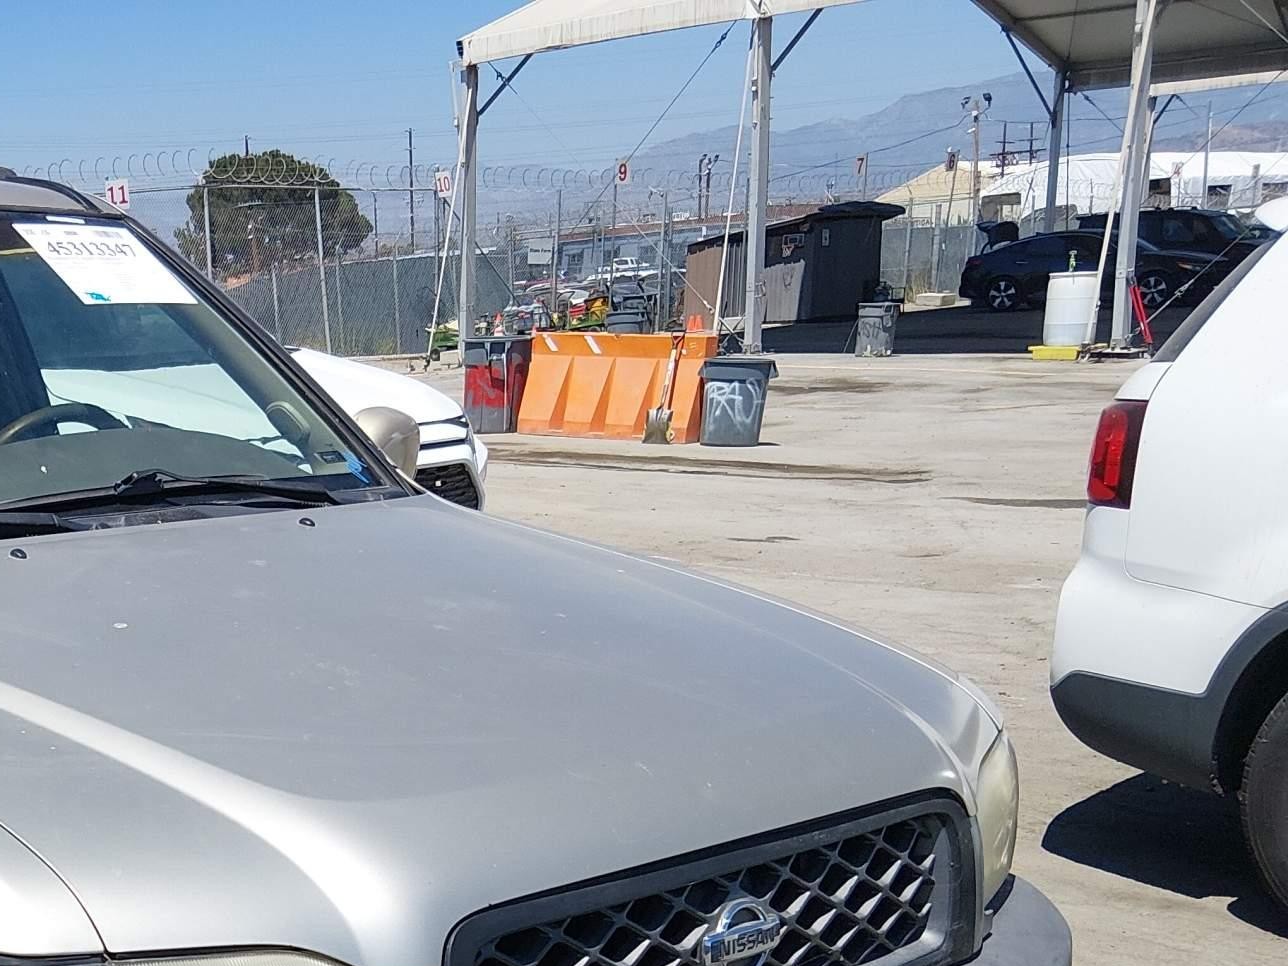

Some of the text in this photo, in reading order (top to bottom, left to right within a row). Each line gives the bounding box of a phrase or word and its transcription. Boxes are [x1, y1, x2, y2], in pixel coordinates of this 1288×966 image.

[856, 157, 865, 175] 7
[948, 153, 956, 169] 6
[617, 163, 628, 182] 9
[437, 175, 451, 193] 10
[106, 184, 129, 205] 11
[47, 240, 137, 257] 45313347
[720, 926, 778, 957] NISSAN
